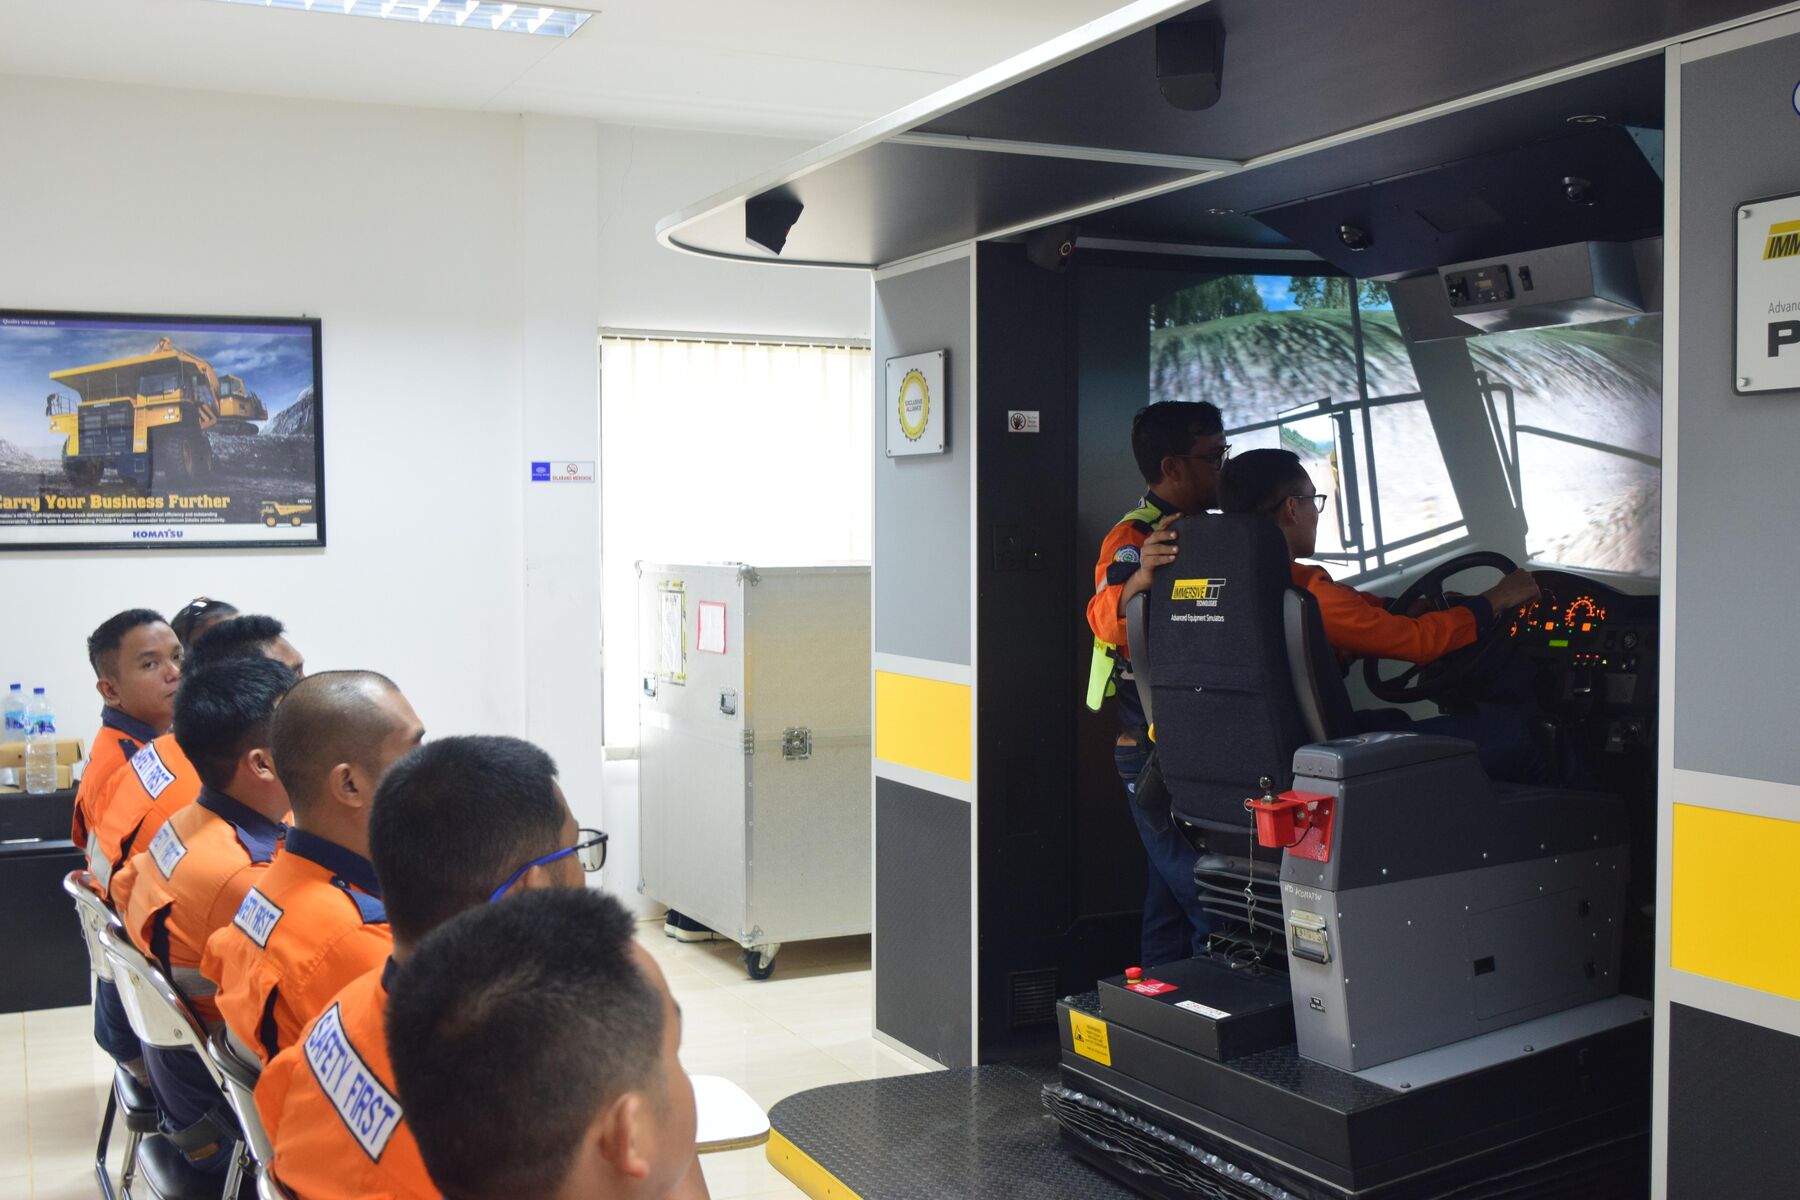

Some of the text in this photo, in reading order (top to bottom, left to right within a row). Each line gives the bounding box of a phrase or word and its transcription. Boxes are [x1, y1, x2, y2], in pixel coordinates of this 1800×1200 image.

[0, 494, 231, 512] arry Your Business Further
[132, 528, 184, 539] KOMATSU
[1173, 586, 1206, 599] IMMERSIVE
[250, 904, 276, 938] FIRST
[309, 1014, 396, 1145] SAFETY FIRST
